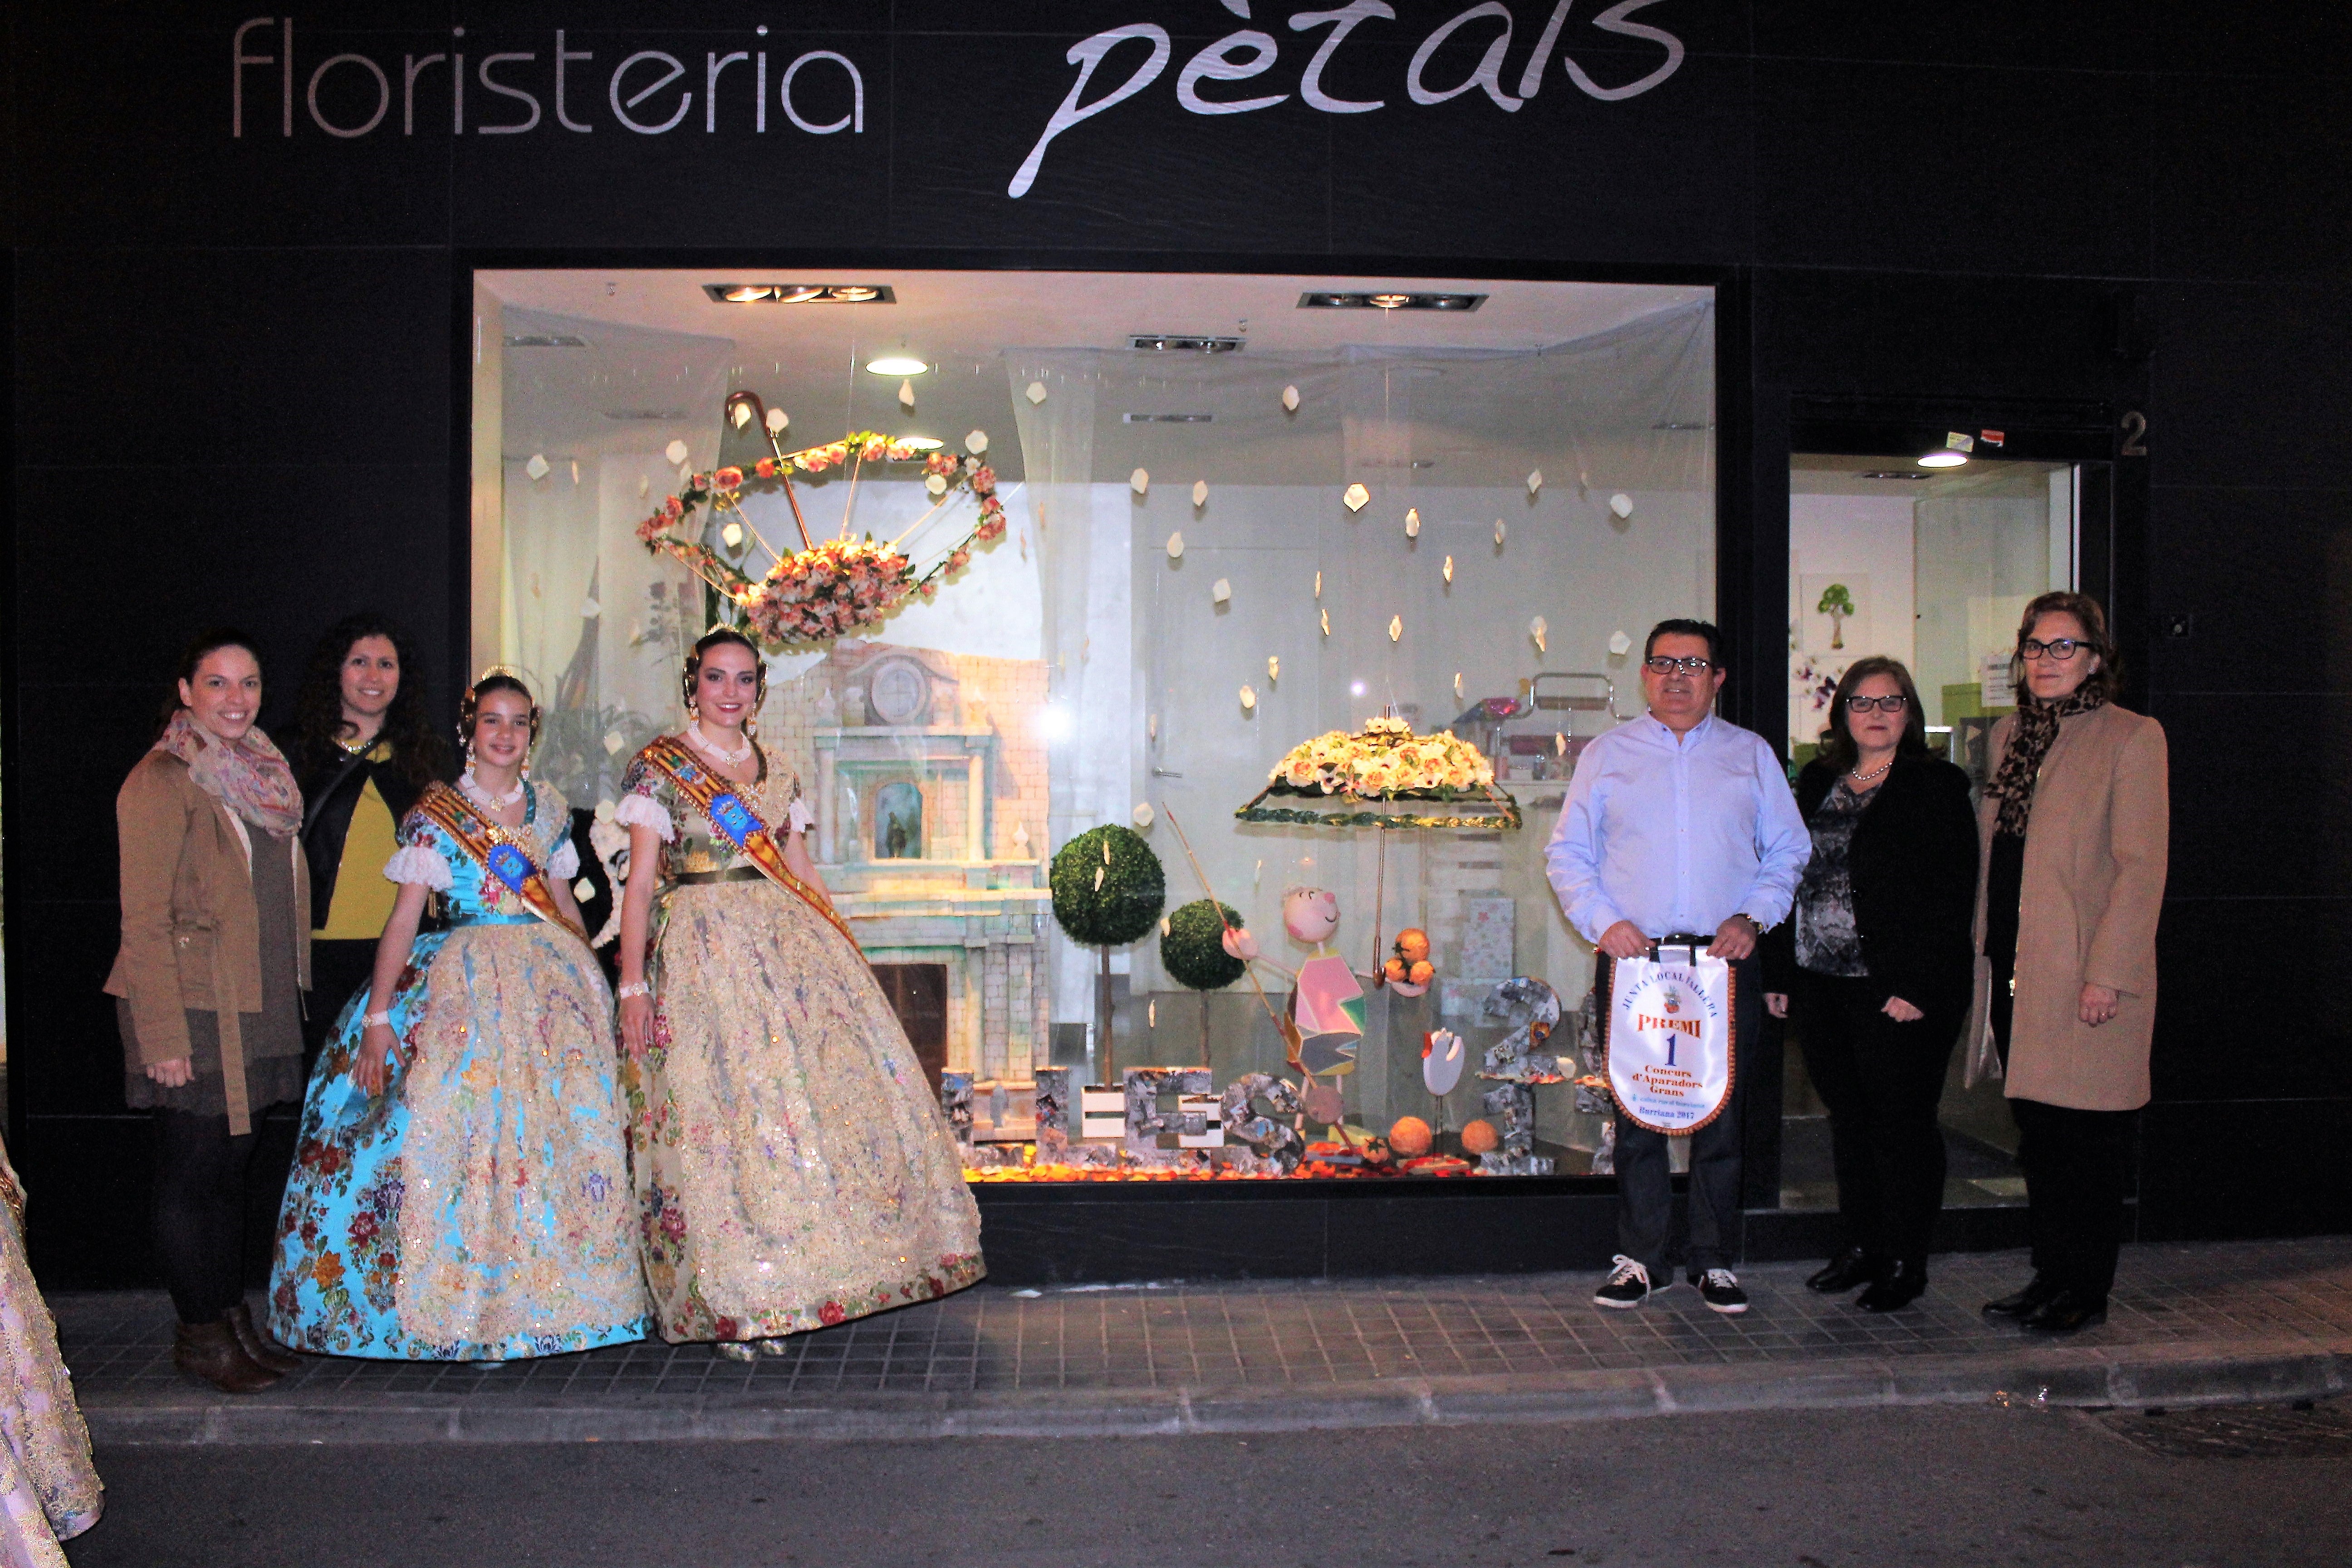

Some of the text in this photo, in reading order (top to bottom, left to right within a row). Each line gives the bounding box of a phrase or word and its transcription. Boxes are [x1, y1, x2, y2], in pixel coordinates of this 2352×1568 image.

[233, 0, 1685, 199] floristeria pètals
[2121, 411, 2146, 456] 2
[1622, 980, 1648, 1010] JUNTA
[1650, 971, 1684, 983] LOCAL
[1637, 1014, 1701, 1039] PREMI
[1665, 1034, 1677, 1066] 1
[1632, 1073, 1703, 1088] d'Aparadors
[1644, 1064, 1692, 1078] Concurs
[1649, 1085, 1684, 1097] Grans
[1639, 1106, 1695, 1119] Burriana 2017
